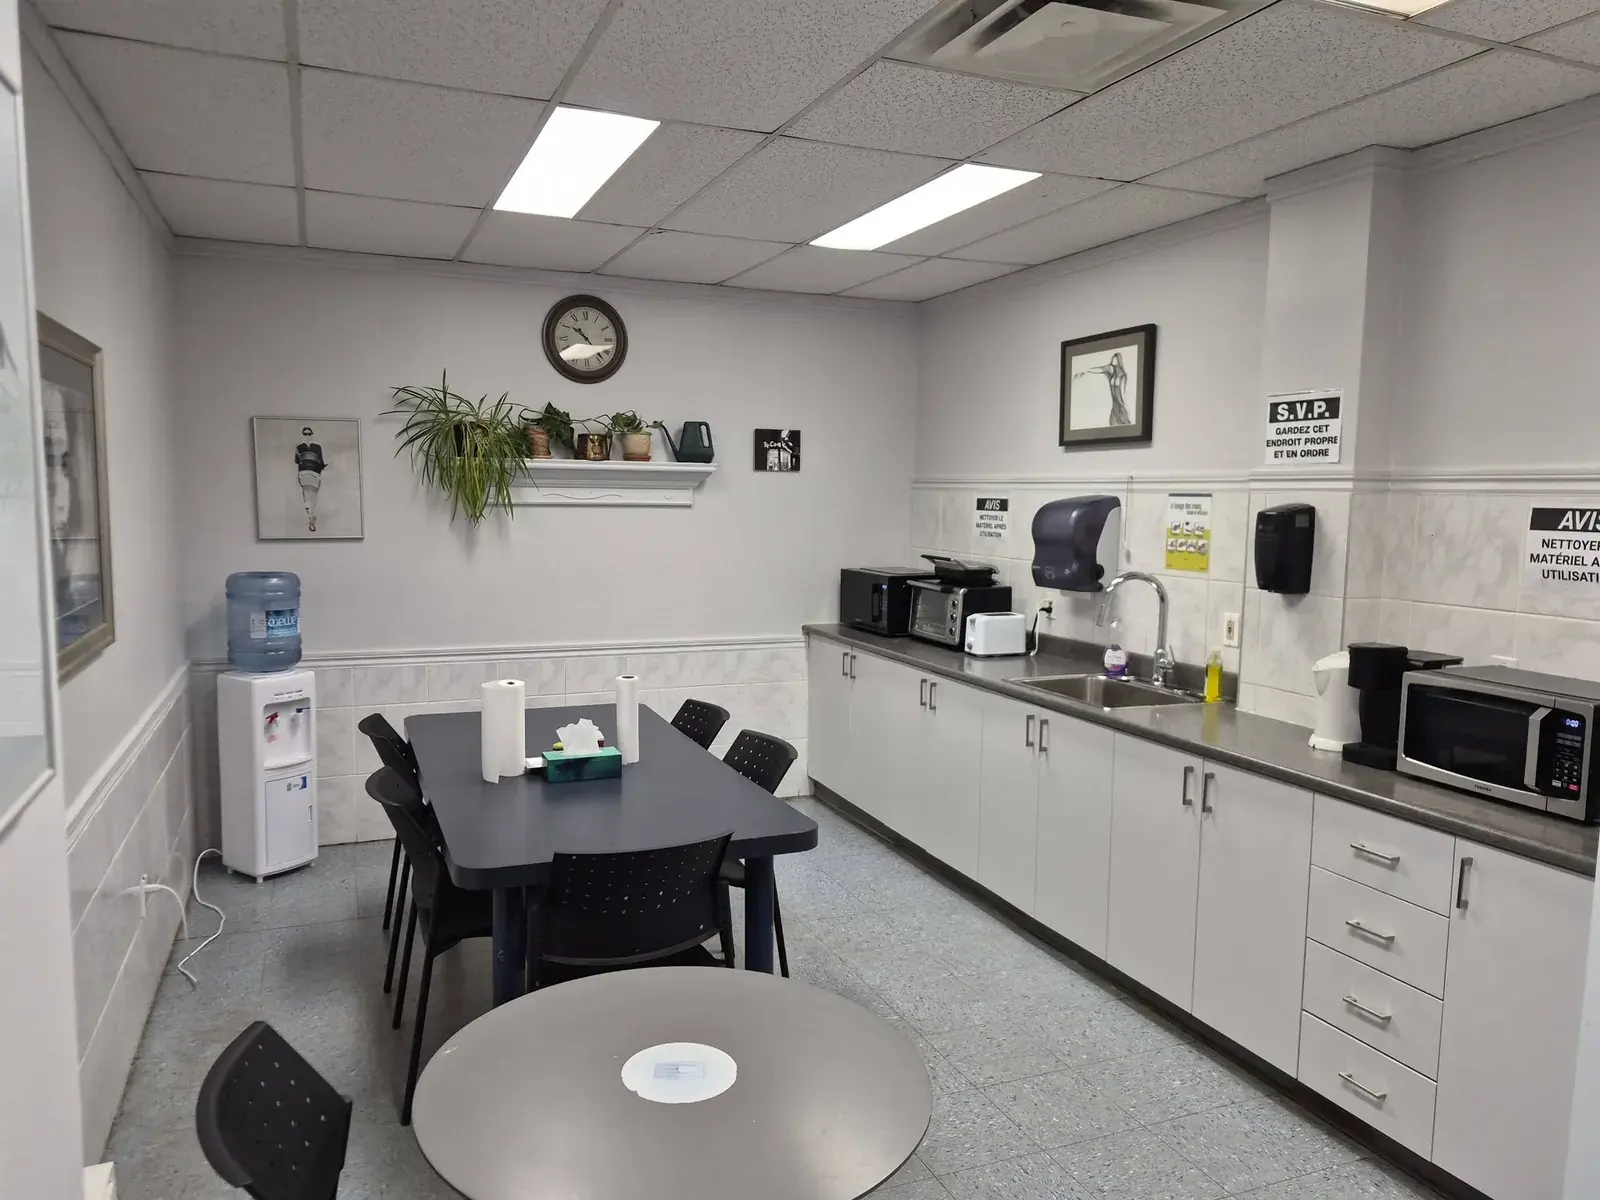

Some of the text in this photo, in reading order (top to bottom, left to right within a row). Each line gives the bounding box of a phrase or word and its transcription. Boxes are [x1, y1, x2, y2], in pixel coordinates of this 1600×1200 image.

[1276, 400, 1330, 421] S.V.P.
[1275, 424, 1330, 436] GARDEZ CET
[1266, 436, 1338, 448] ENDROIT PROPRE
[1273, 448, 1330, 459] ET EN ORDRE
[984, 499, 1001, 511] AVIS
[1529, 552, 1588, 567] MATÉRIEL
